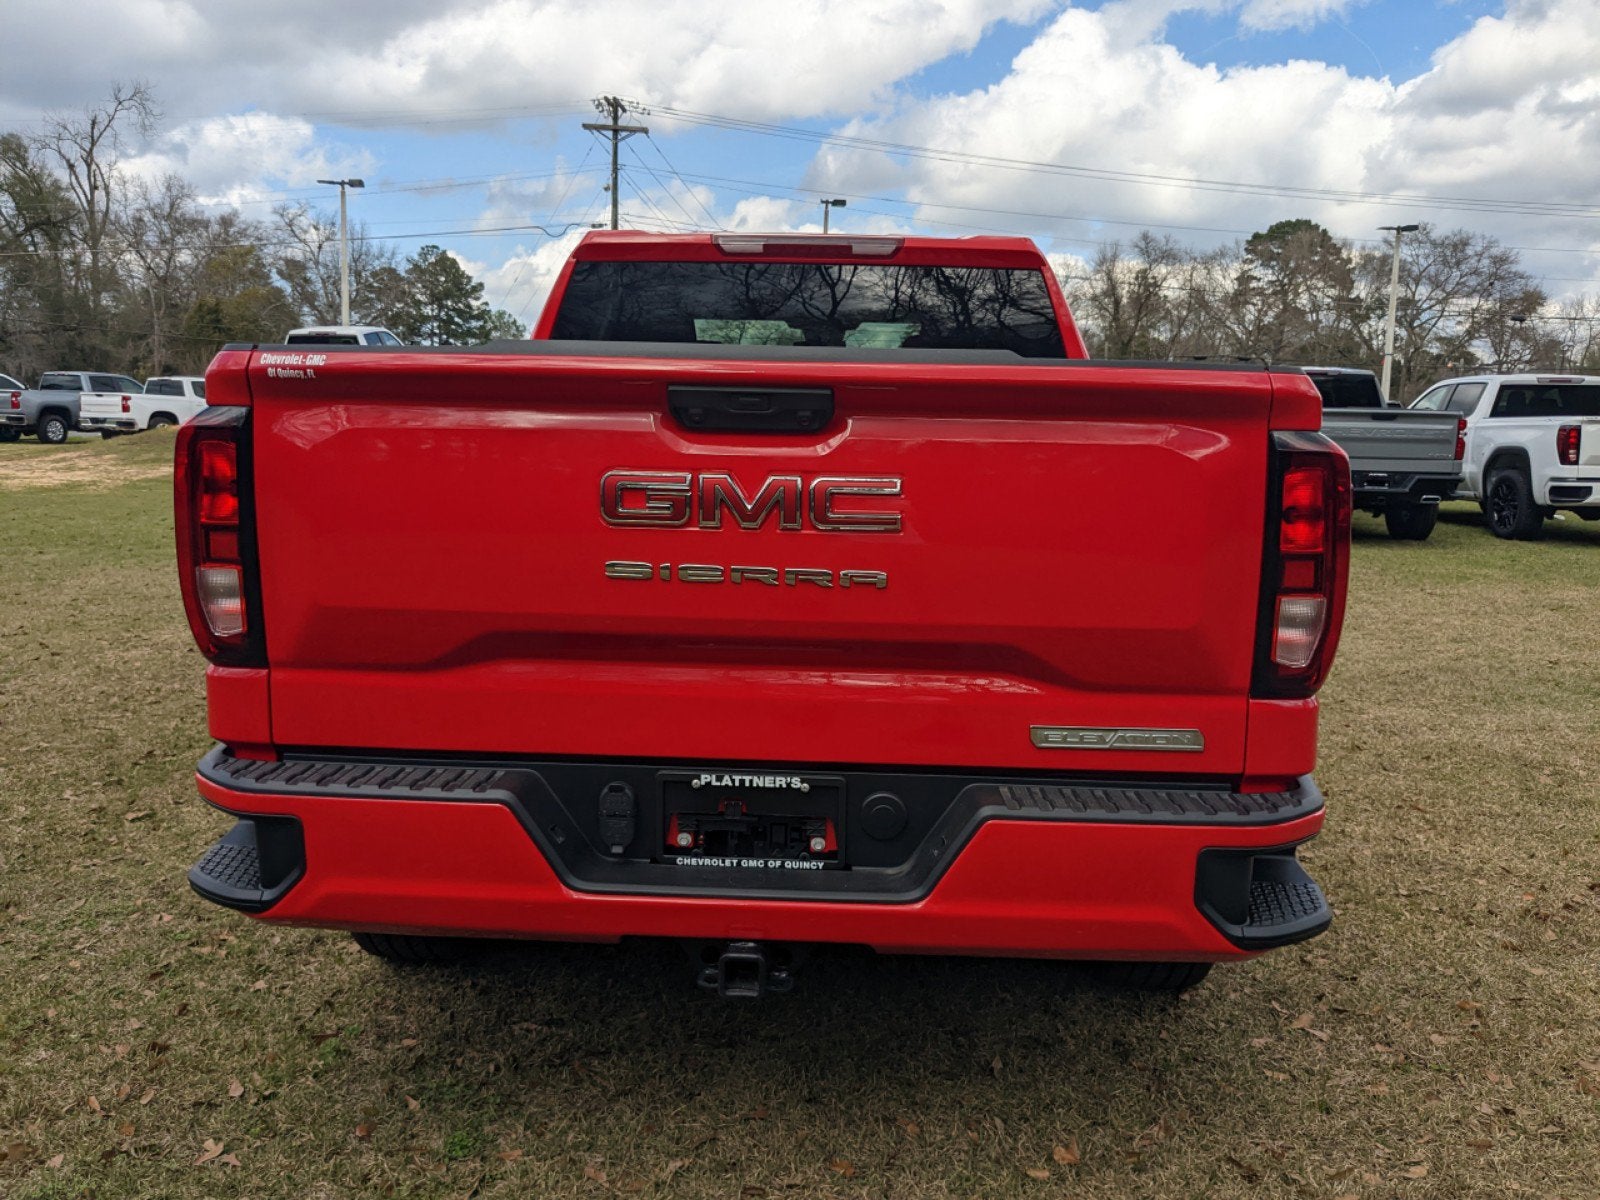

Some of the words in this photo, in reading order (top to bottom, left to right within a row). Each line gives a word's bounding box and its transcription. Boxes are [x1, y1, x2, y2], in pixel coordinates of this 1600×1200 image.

[260, 353, 327, 365] Chevrolet-GMC
[600, 469, 904, 532] GMC
[604, 560, 888, 589] SIERRA
[1043, 730, 1192, 745] ELEVATION
[700, 774, 802, 789] PLATTNER'S
[676, 857, 738, 867] CHEVROLET
[741, 859, 764, 868] GMC
[768, 860, 782, 868] OF
[784, 861, 824, 870] QUINCY
